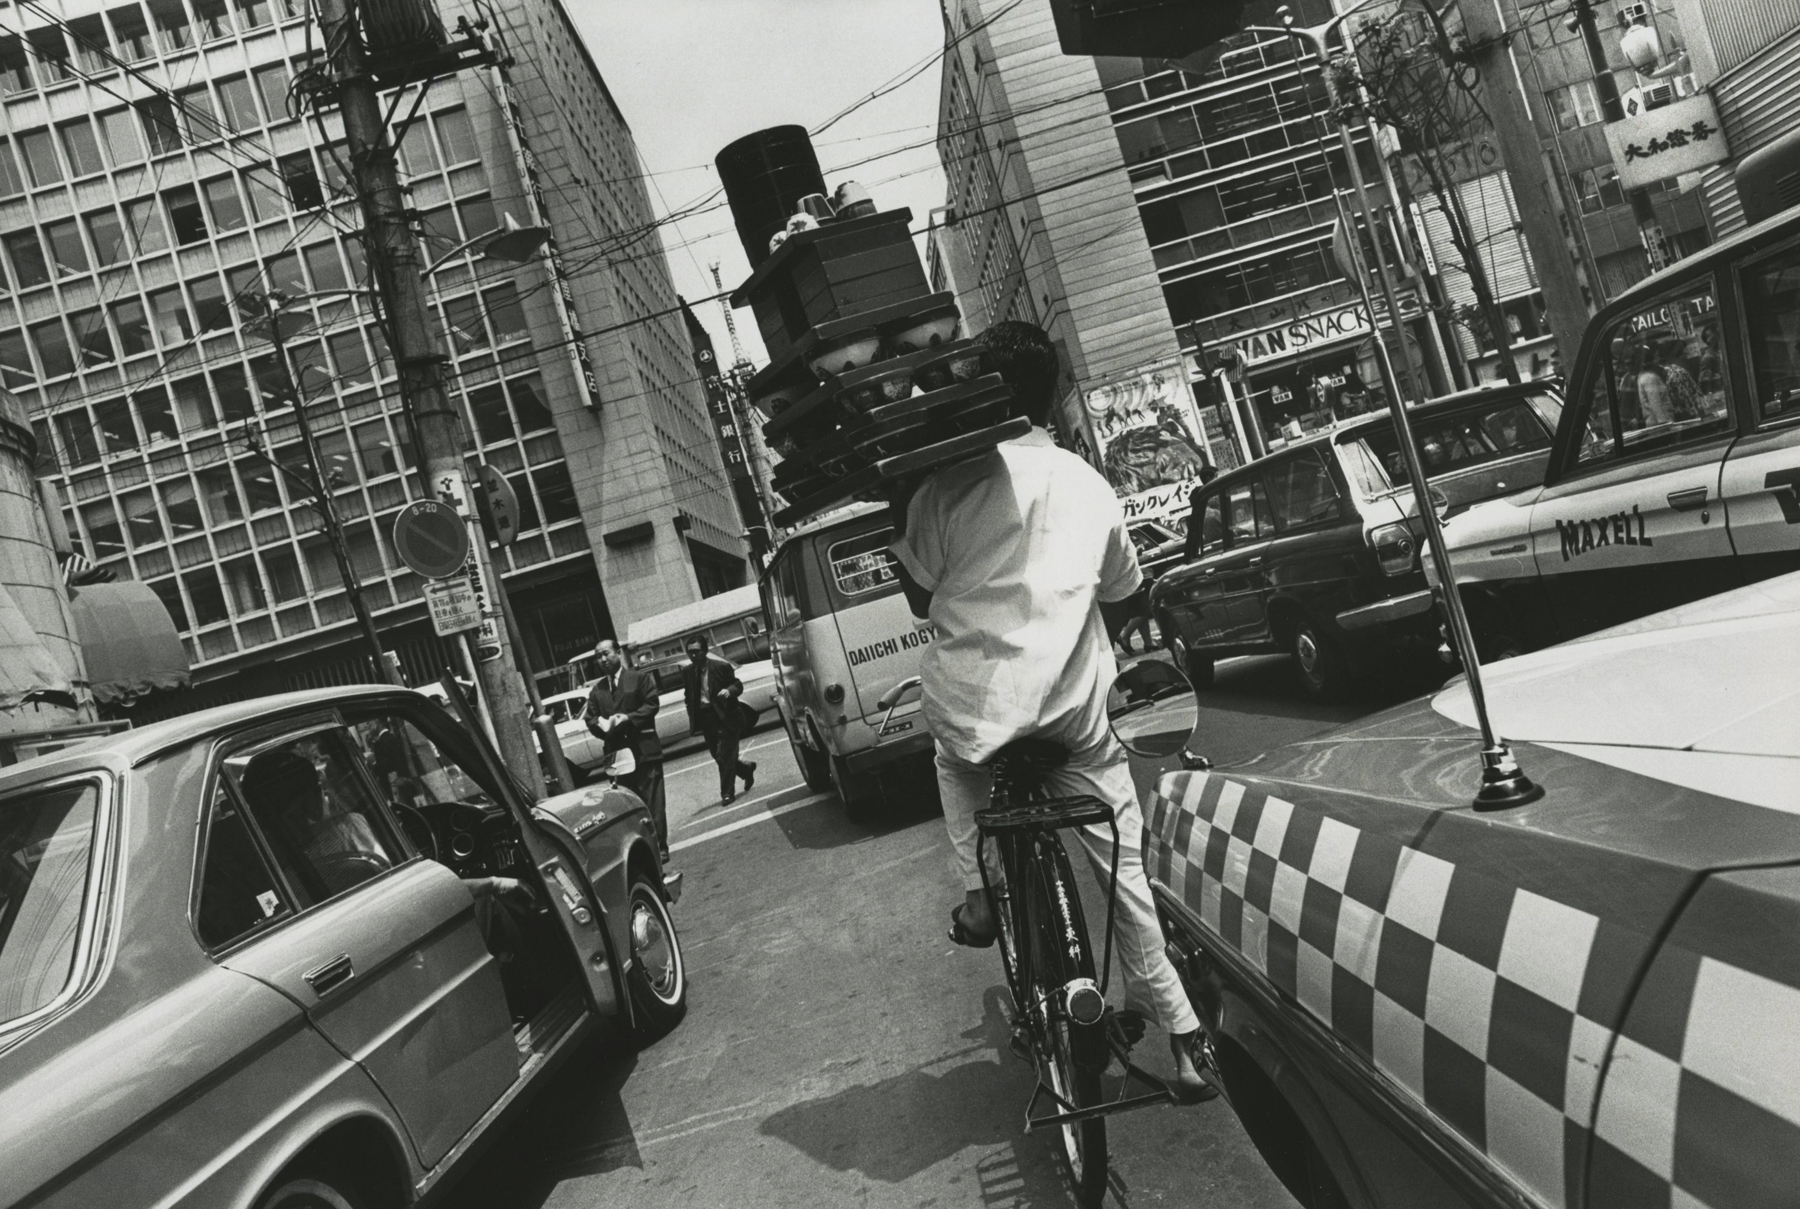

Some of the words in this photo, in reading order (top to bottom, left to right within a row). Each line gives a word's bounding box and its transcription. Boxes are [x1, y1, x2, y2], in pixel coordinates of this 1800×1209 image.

[515, 149, 535, 212] FUJI
[1234, 332, 1287, 361] VAN
[1289, 305, 1373, 348] SNACK
[1273, 392, 1291, 403] VAN
[411, 503, 438, 516] 8-20
[1555, 504, 1653, 562] MAXELL
[848, 637, 899, 667] DAIICHI
[900, 625, 938, 650] KOGY
